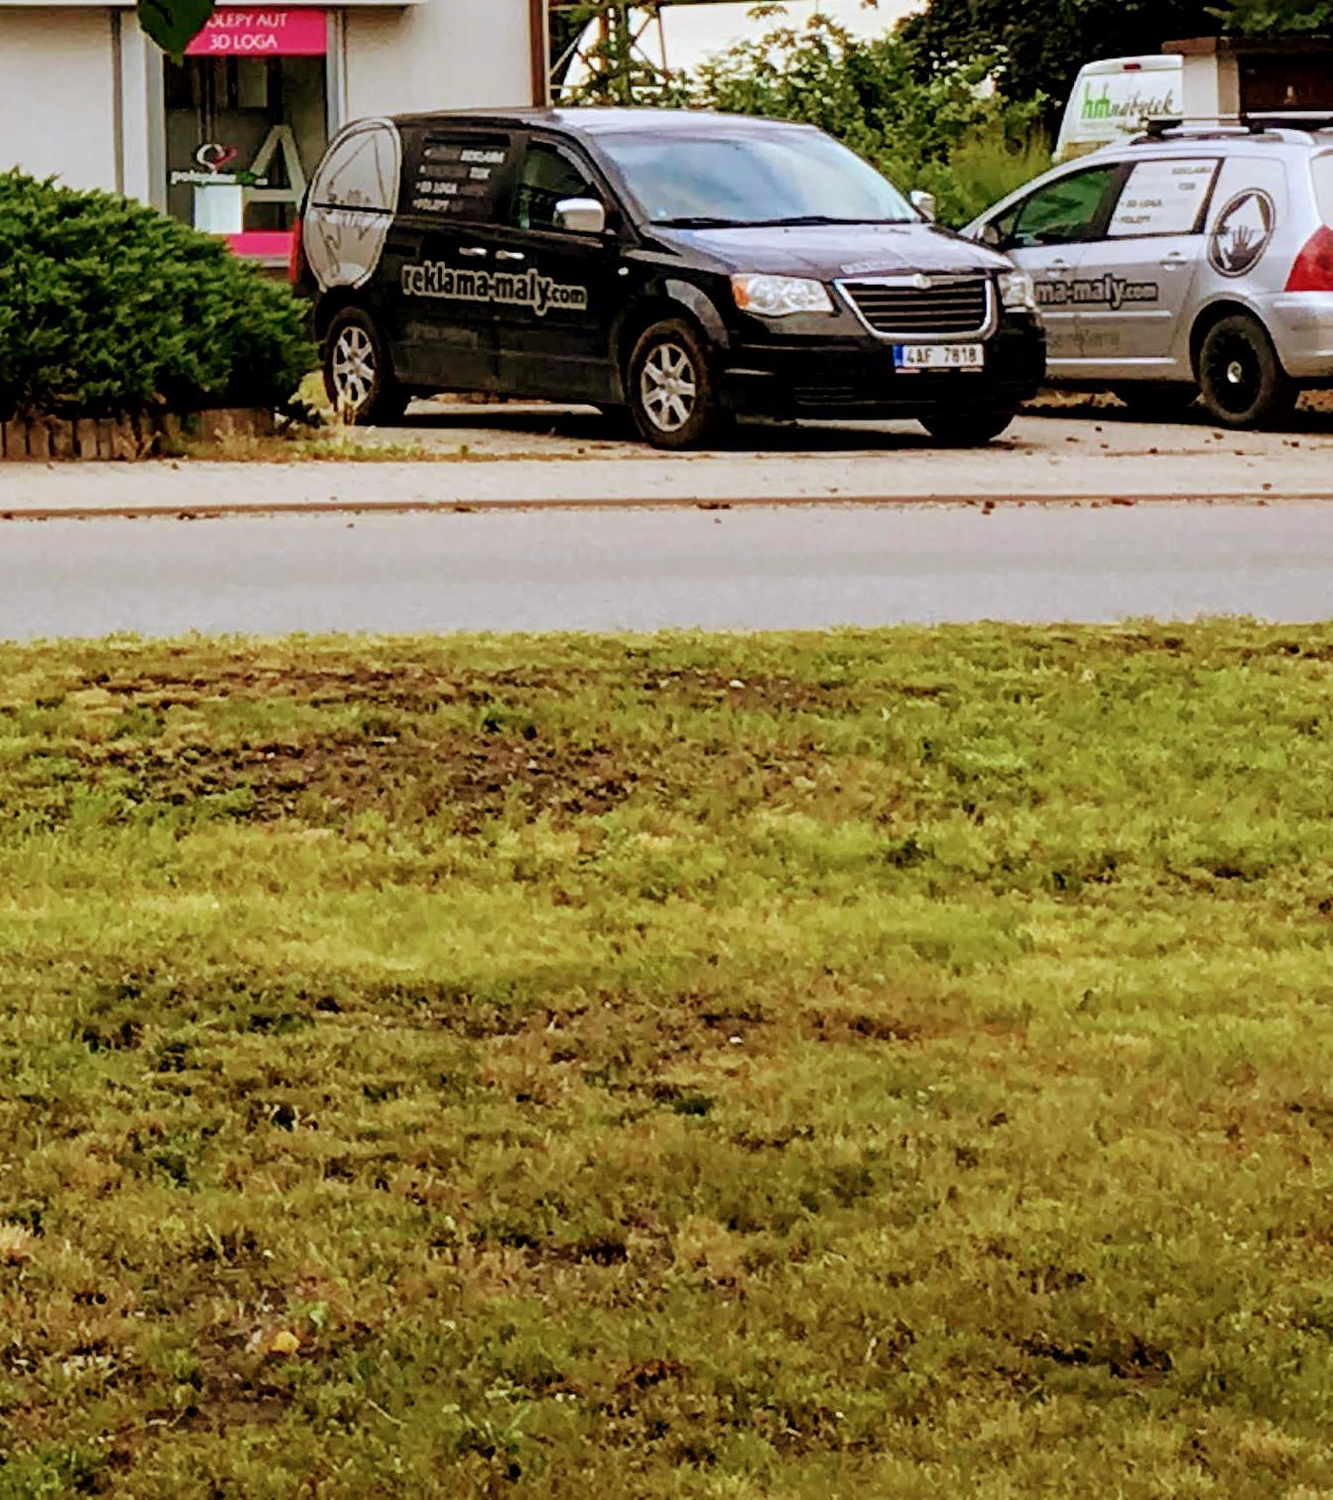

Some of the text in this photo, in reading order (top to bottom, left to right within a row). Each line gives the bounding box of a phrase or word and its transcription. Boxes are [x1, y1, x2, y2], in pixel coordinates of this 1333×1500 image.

[206, 12, 288, 28] OLEPY AUT
[209, 34, 278, 50] 3D LOGA
[402, 260, 587, 316] reklama-maly.com
